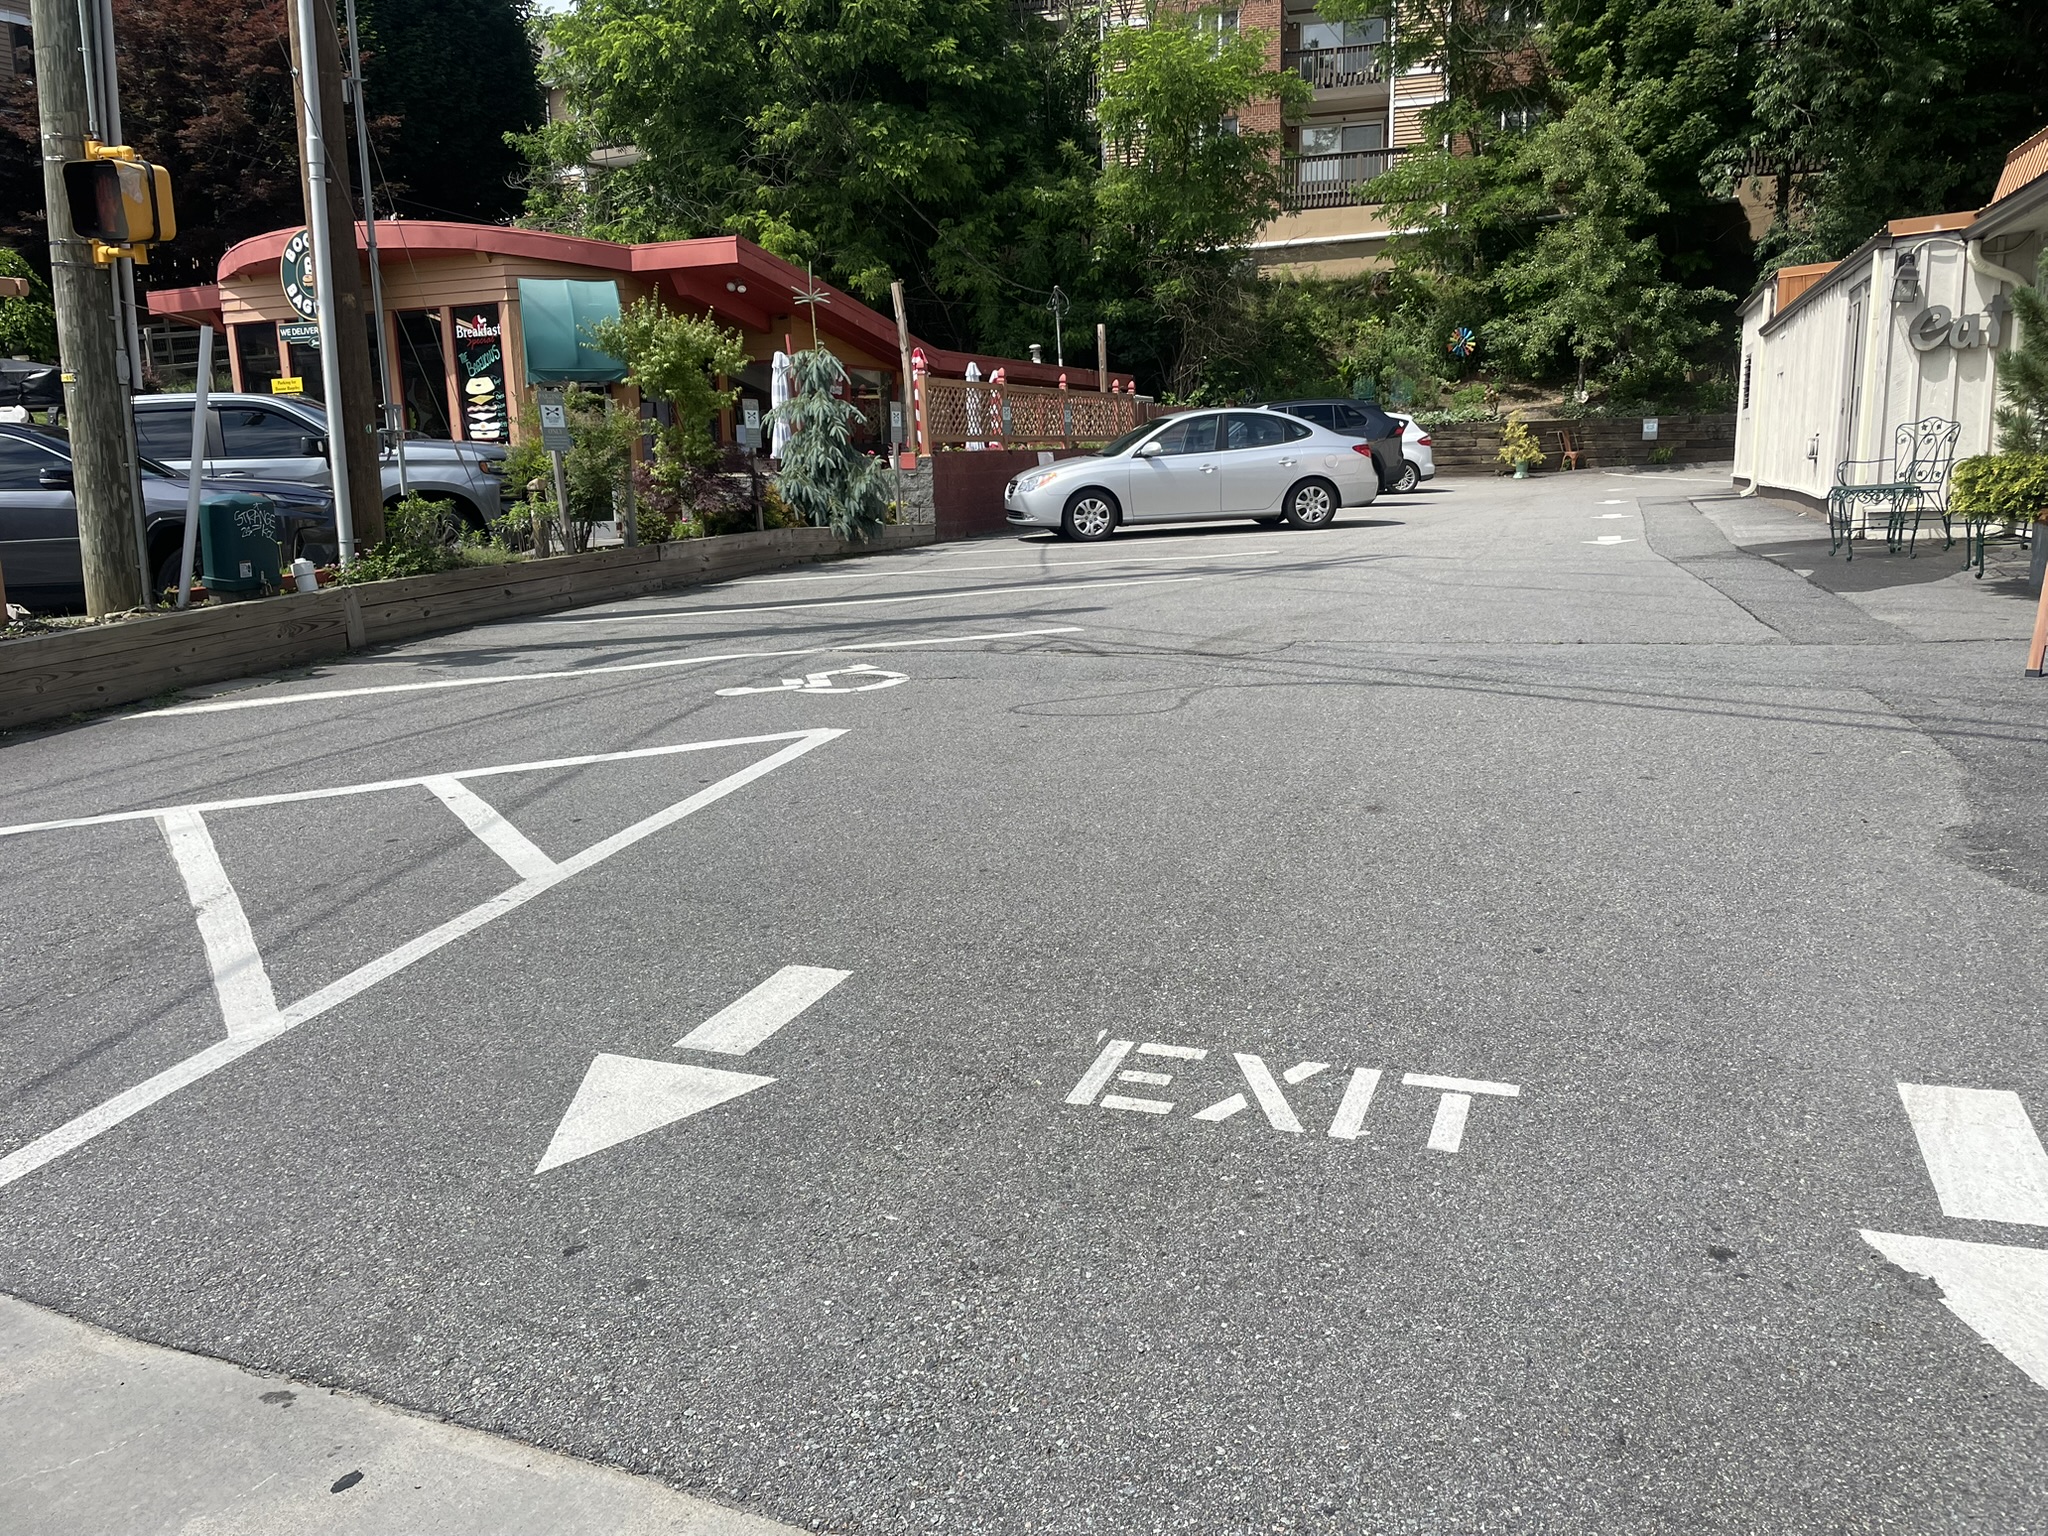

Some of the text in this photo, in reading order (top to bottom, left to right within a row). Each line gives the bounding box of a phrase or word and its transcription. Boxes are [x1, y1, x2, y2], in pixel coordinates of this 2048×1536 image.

[287, 283, 317, 314] BAG
[280, 326, 319, 336] WE DELIVER
[456, 322, 501, 338] Breakfast
[1909, 294, 2013, 351] eat
[234, 509, 276, 529] STRANGE
[1065, 1039, 1521, 1153] EXIT
